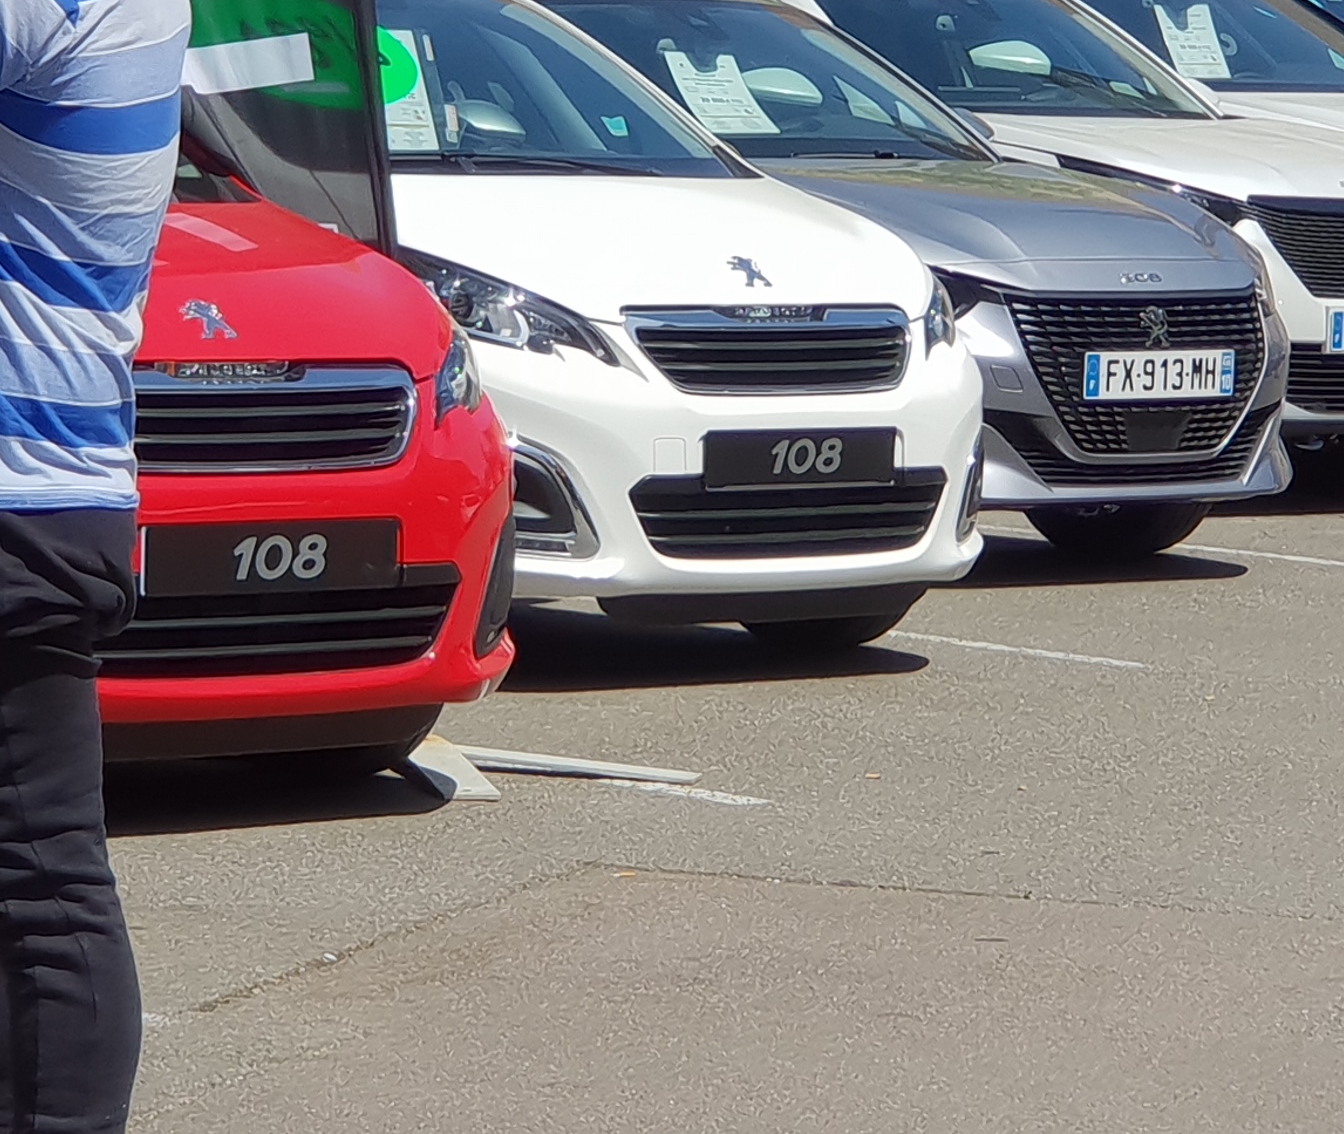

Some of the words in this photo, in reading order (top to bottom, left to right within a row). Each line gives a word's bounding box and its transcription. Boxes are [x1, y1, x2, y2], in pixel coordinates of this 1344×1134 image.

[1106, 356, 1217, 393] FX-913-MH
[771, 437, 843, 475] 108
[233, 533, 328, 581] 108
